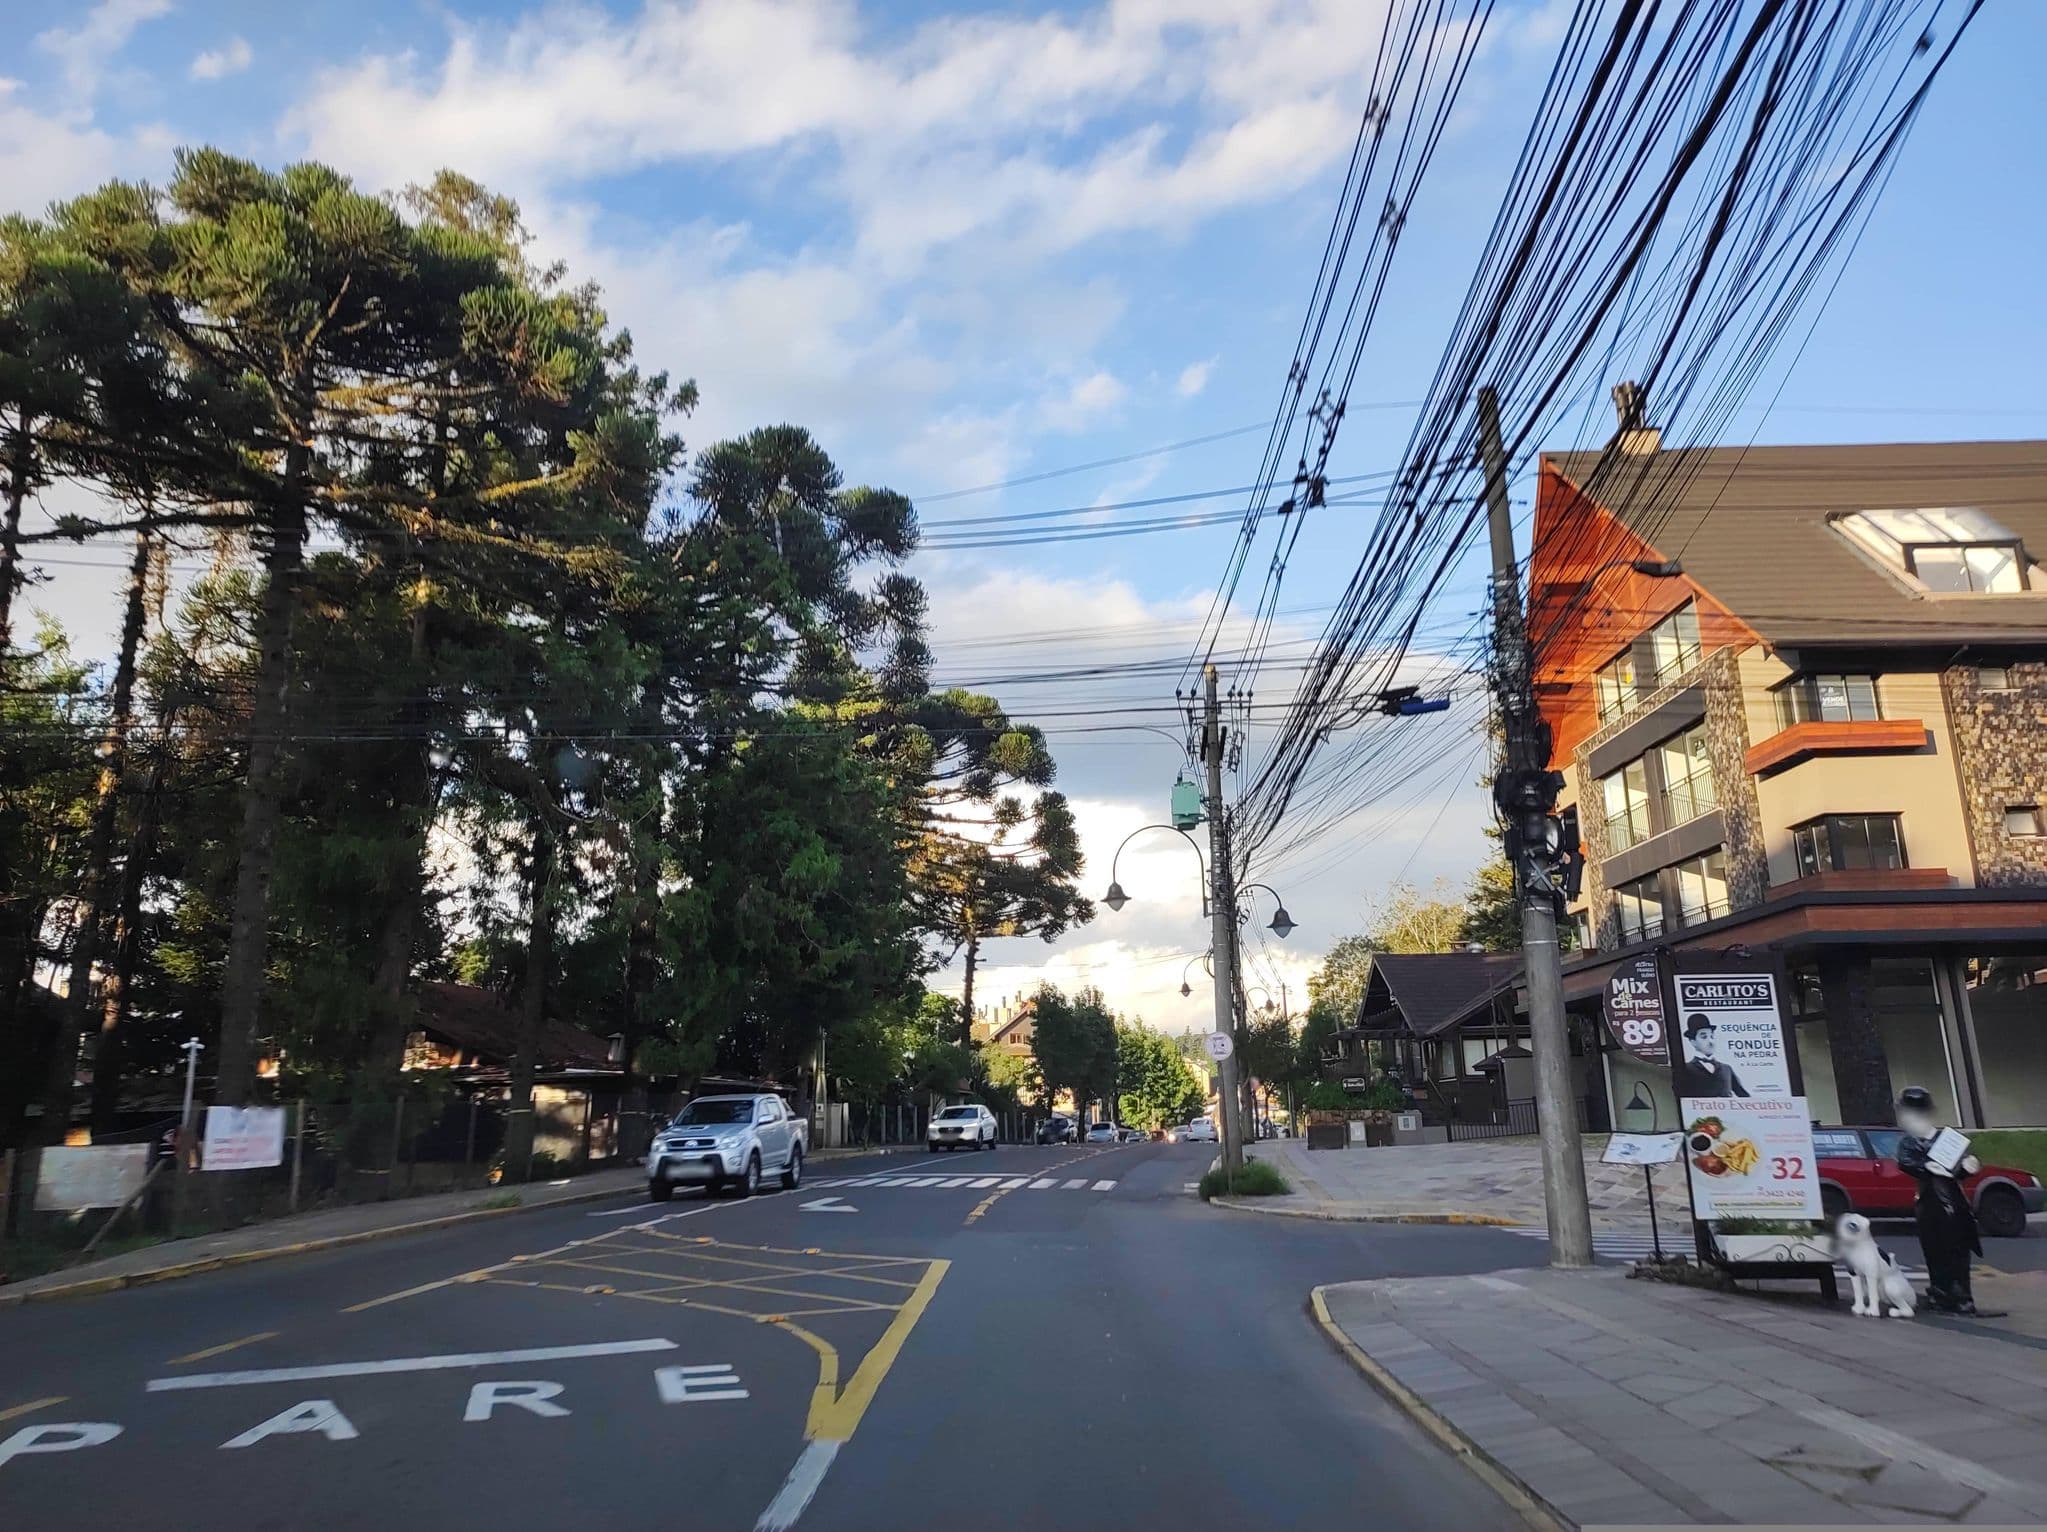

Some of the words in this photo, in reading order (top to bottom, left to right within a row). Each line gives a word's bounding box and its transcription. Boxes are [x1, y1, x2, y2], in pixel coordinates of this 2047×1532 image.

[1612, 978, 1649, 994] Mix
[1685, 984, 1769, 998] CARLITO'S
[1618, 991, 1633, 1001] de
[1611, 998, 1660, 1009] Carnes
[1622, 1019, 1660, 1045] 89
[1720, 1022, 1777, 1034] SEQUÊNCIA
[1728, 1040, 1781, 1050] FONDUE
[1748, 1050, 1778, 1058] PEDRA
[1691, 1100, 1726, 1111] Prato
[1730, 1099, 1793, 1111] Executivo
[1771, 1157, 1806, 1180] 32
[0, 1364, 750, 1465] PARE
